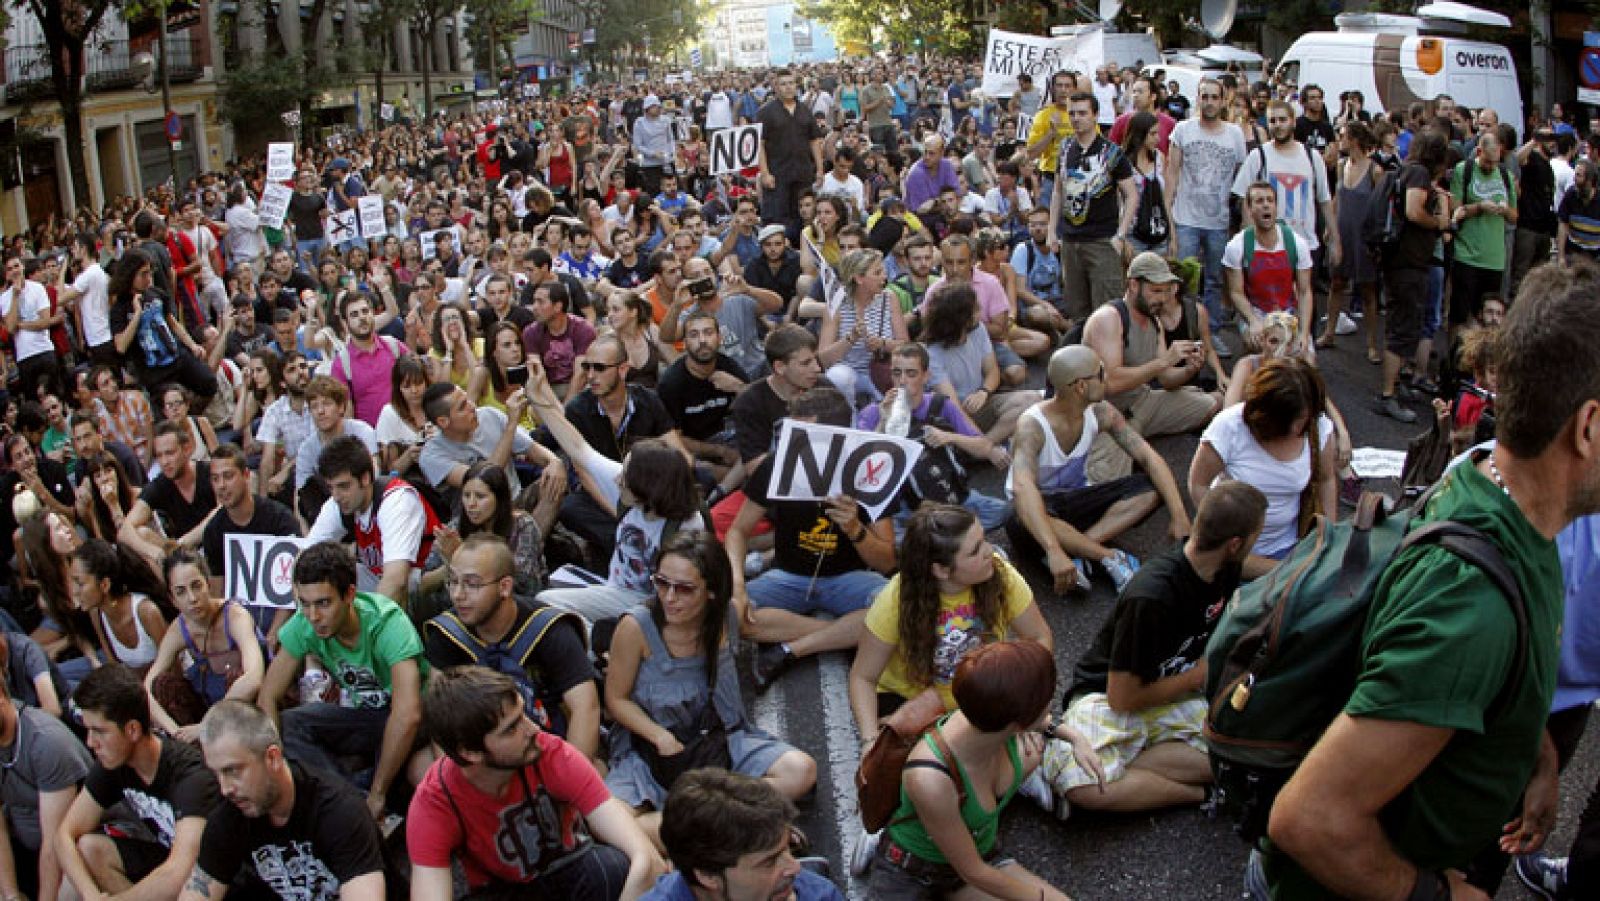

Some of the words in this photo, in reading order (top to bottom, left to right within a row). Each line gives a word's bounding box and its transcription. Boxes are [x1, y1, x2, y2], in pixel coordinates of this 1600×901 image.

[990, 57, 1014, 75] MI
[992, 39, 1037, 61] ESTE
[1456, 51, 1508, 70] overon
[713, 127, 758, 171] NO
[777, 427, 906, 508] NO
[229, 539, 298, 605] NO
